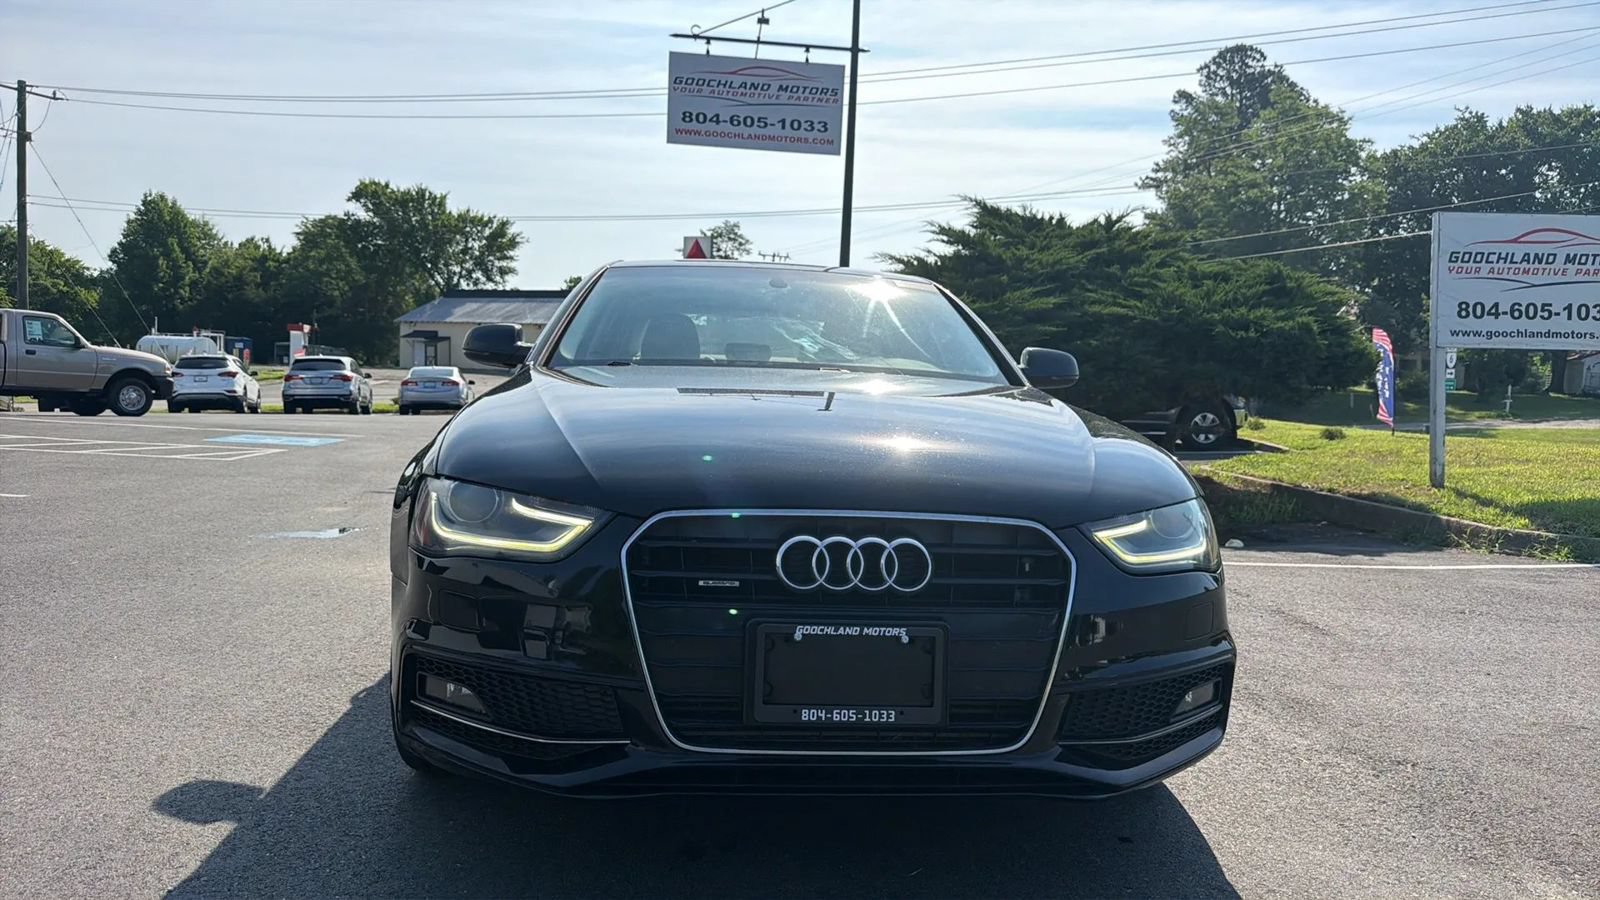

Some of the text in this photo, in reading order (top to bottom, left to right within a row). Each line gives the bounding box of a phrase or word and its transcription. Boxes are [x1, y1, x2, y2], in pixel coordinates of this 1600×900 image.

[673, 76, 840, 97] GOOCHLAND MOTORS
[672, 86, 839, 105] YOUR AUTOMOTIVE PARTNER
[681, 111, 829, 133] 804-605-1033
[675, 127, 834, 146] WWW.GOOCHLANDMOTORS.COM
[1448, 251, 1600, 266] GOOCHLAND MOT
[1448, 266, 1481, 275] YOUR
[1487, 267, 1569, 276] AUTOMOTIVE
[1450, 328, 1600, 340] www.goochlandmotors.
[796, 625, 907, 637] GOOCHLAND MOTORS
[801, 709, 896, 722] 804-605-1033
